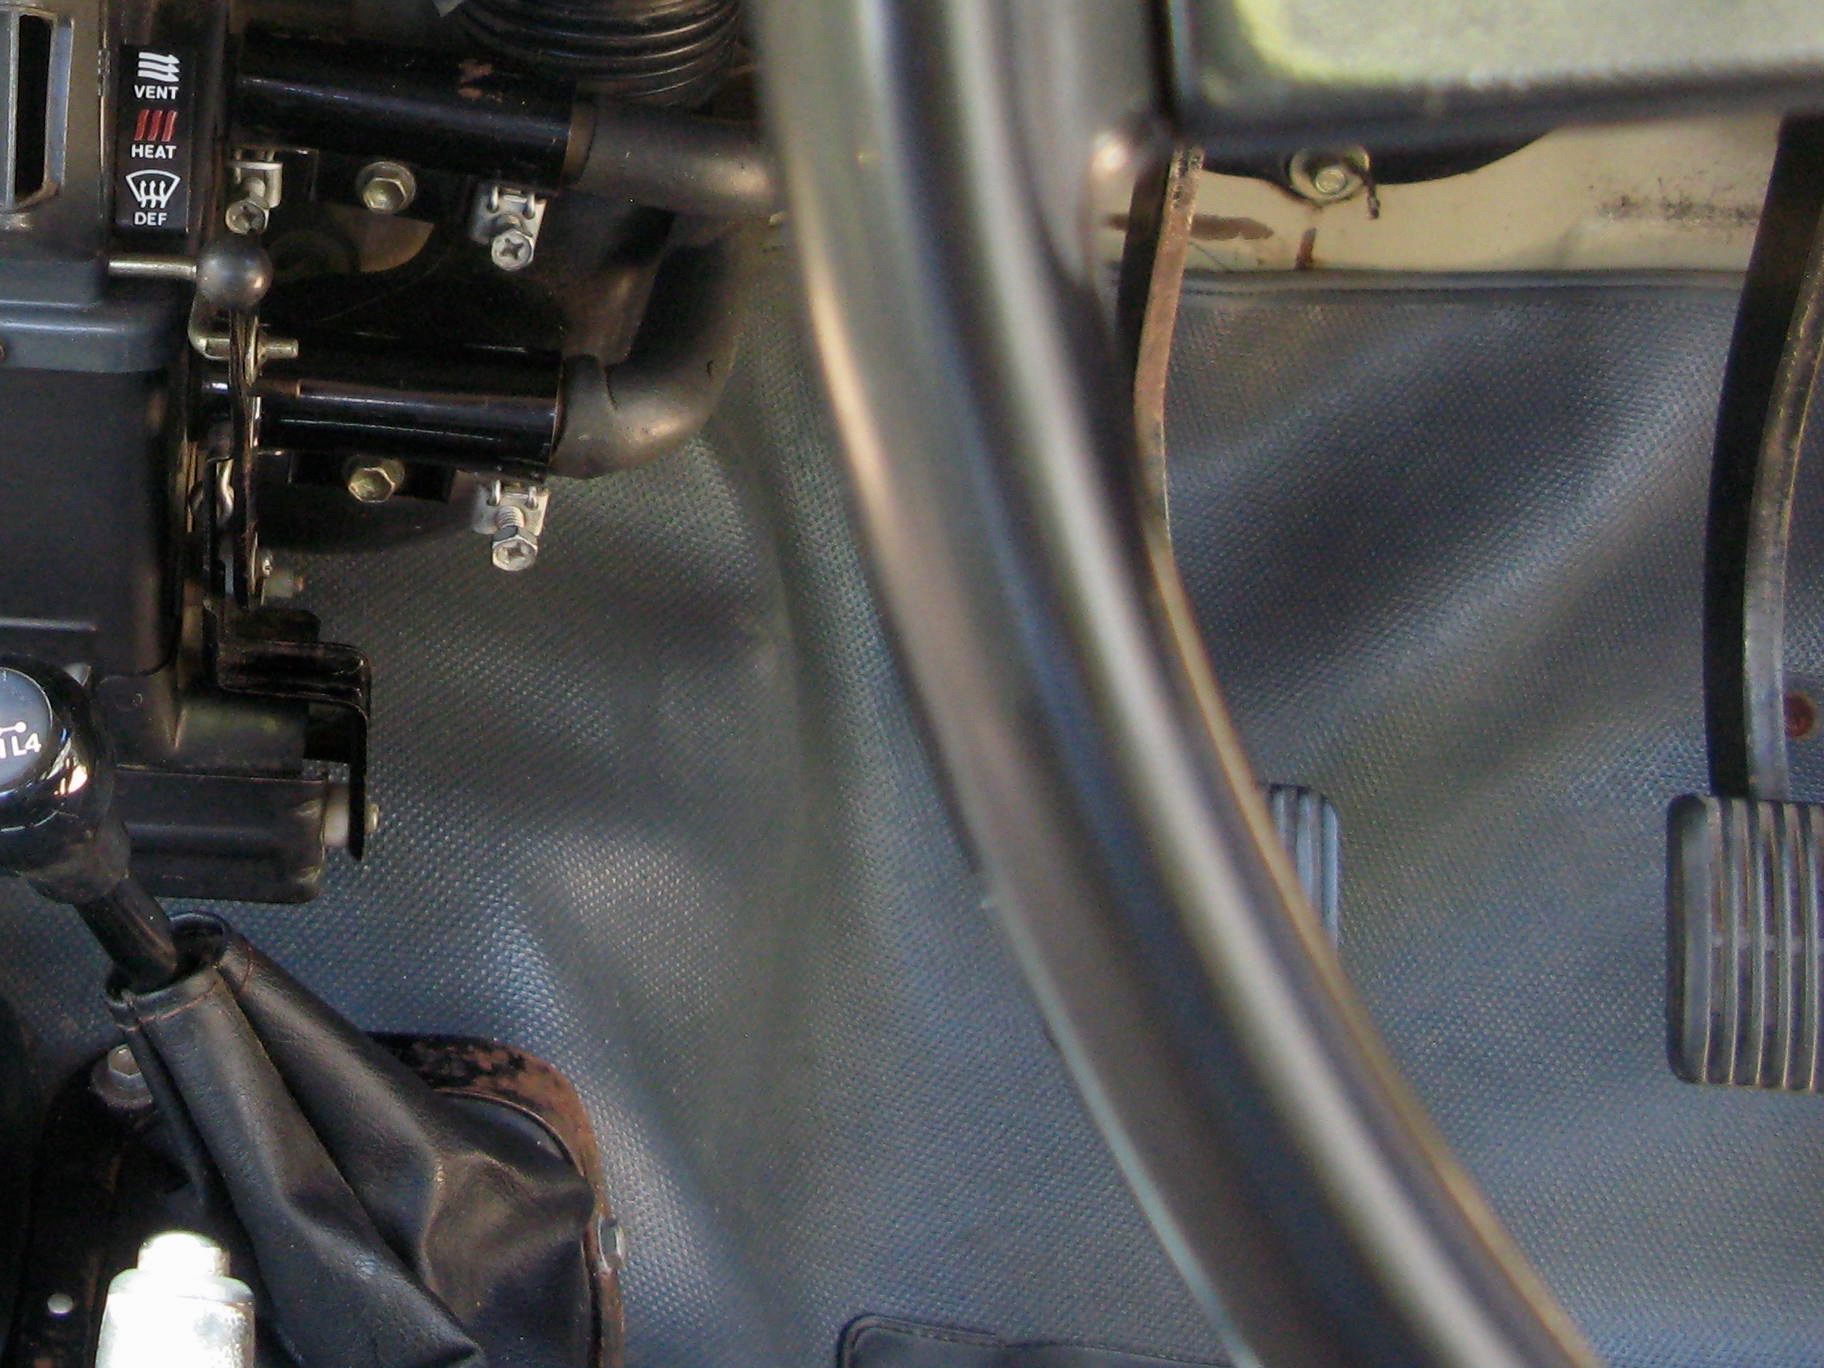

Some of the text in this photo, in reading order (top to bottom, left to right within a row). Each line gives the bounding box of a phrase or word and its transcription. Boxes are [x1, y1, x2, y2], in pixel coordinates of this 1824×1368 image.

[134, 85, 179, 99] VENT
[131, 144, 177, 159] HEAT
[134, 212, 167, 226] DEF
[11, 733, 42, 756] L4
